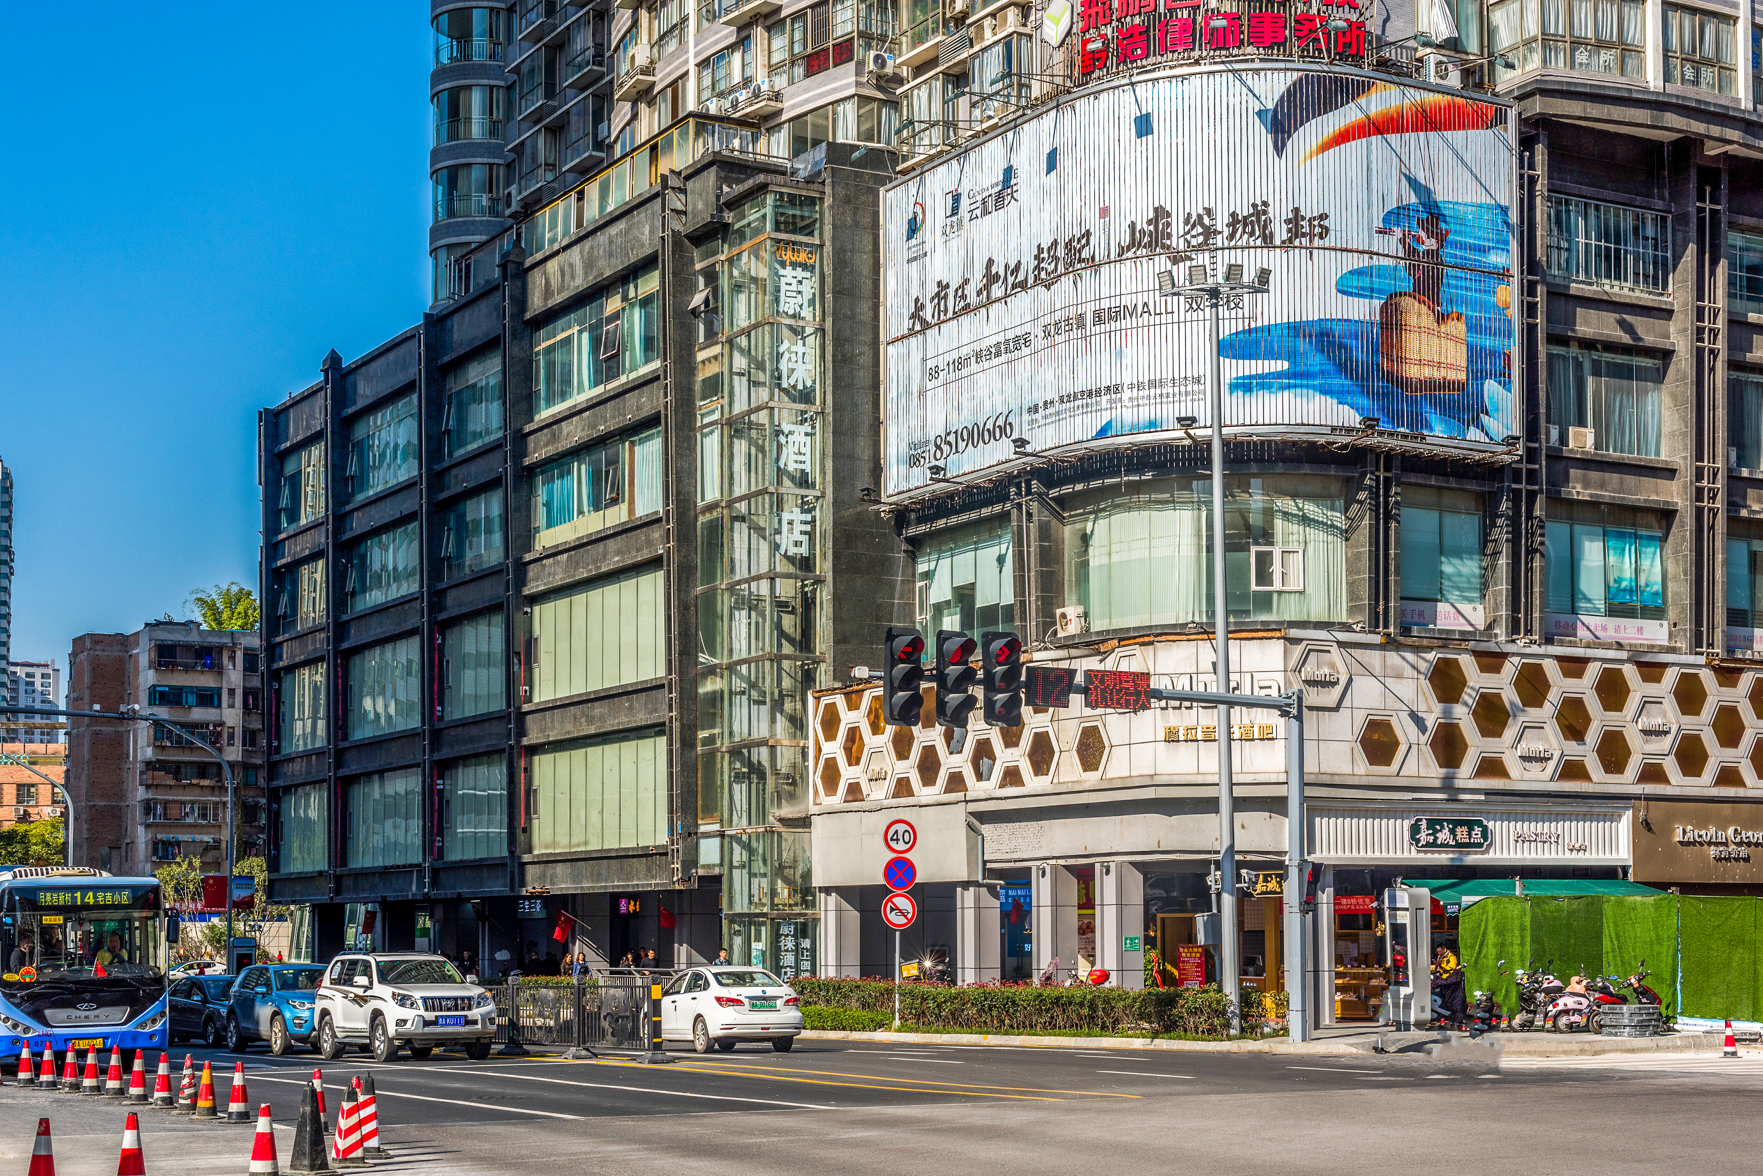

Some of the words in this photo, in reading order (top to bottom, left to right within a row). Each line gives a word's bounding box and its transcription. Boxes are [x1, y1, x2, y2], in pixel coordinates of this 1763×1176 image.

[1575, 46, 1616, 68] 会所
[1683, 64, 1714, 85] 会所
[967, 182, 1019, 222] 云和春天
[1117, 200, 1330, 265] 峡谷城邦
[777, 266, 813, 558] 蔚徕酒店
[908, 448, 931, 469] 0851
[933, 408, 1014, 462] 85190666
[1036, 668, 1069, 706] 12
[1087, 670, 1151, 690] 文明驾驶
[1087, 688, 1152, 710] 礼让行人
[889, 828, 912, 845] 40
[1415, 818, 1485, 848] 嘉诚糕点
[1512, 829, 1560, 843] PASTRY
[39, 892, 72, 906] 月亮岩新村
[74, 891, 95, 905] 14
[96, 891, 129, 905] 宅吉小区
